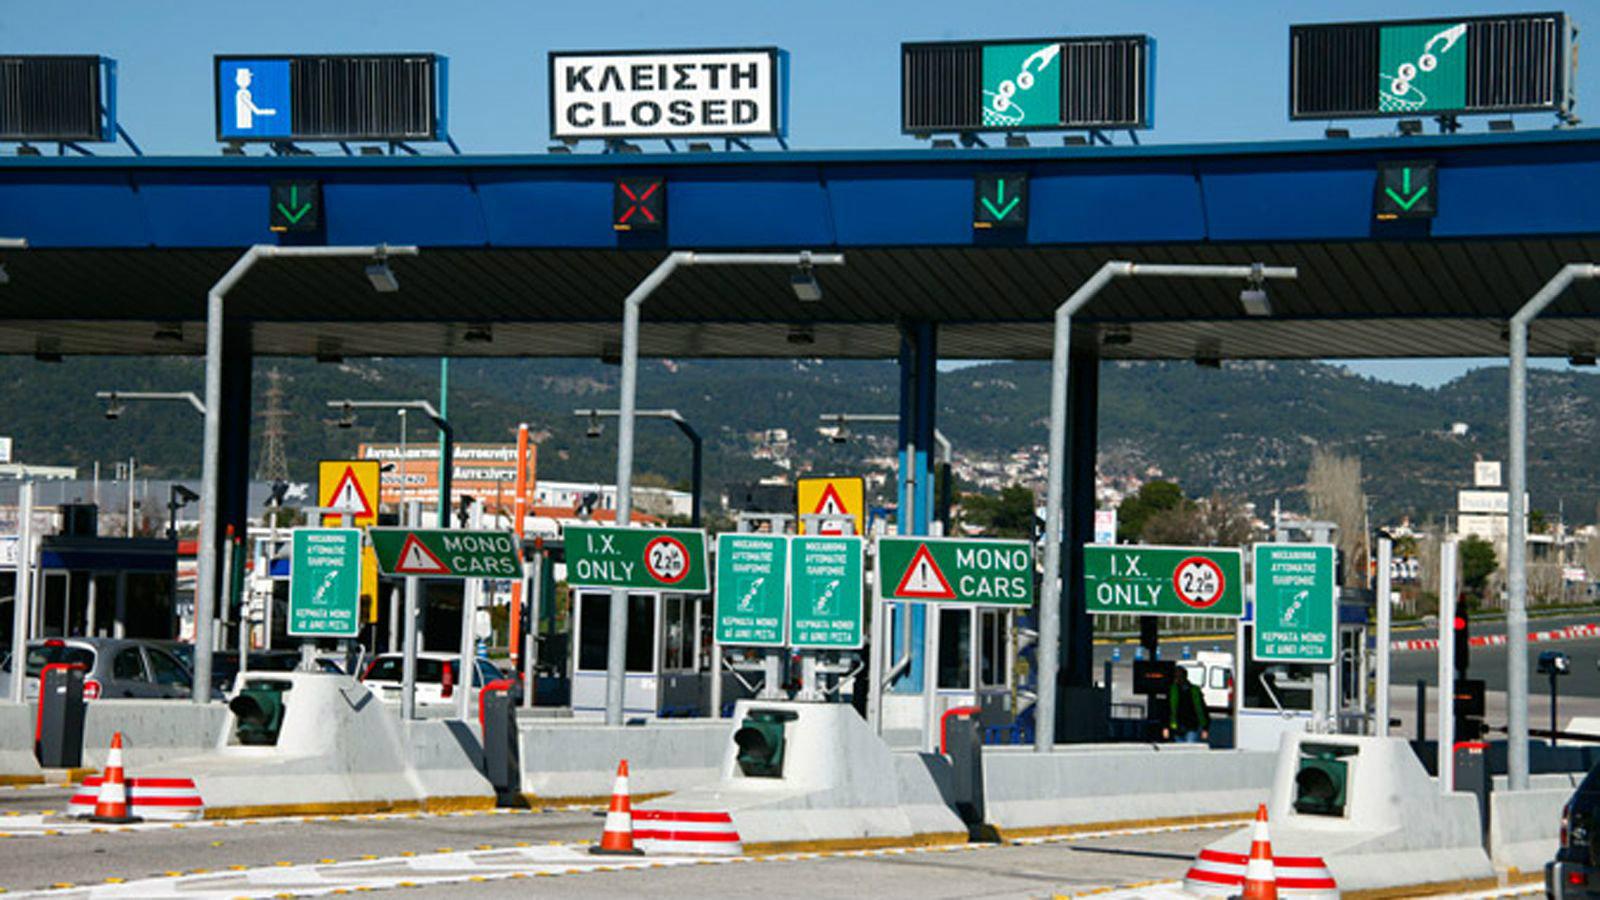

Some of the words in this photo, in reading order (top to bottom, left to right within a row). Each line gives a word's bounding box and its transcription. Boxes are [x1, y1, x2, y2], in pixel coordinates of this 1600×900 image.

[566, 63, 758, 92] ΚΛΕΙΣΤΗ
[566, 100, 759, 127] CLOSED
[452, 556, 515, 574] CARS
[577, 559, 634, 581] ONLY
[960, 575, 1027, 598] CARS
[1097, 583, 1162, 606] ONLY
